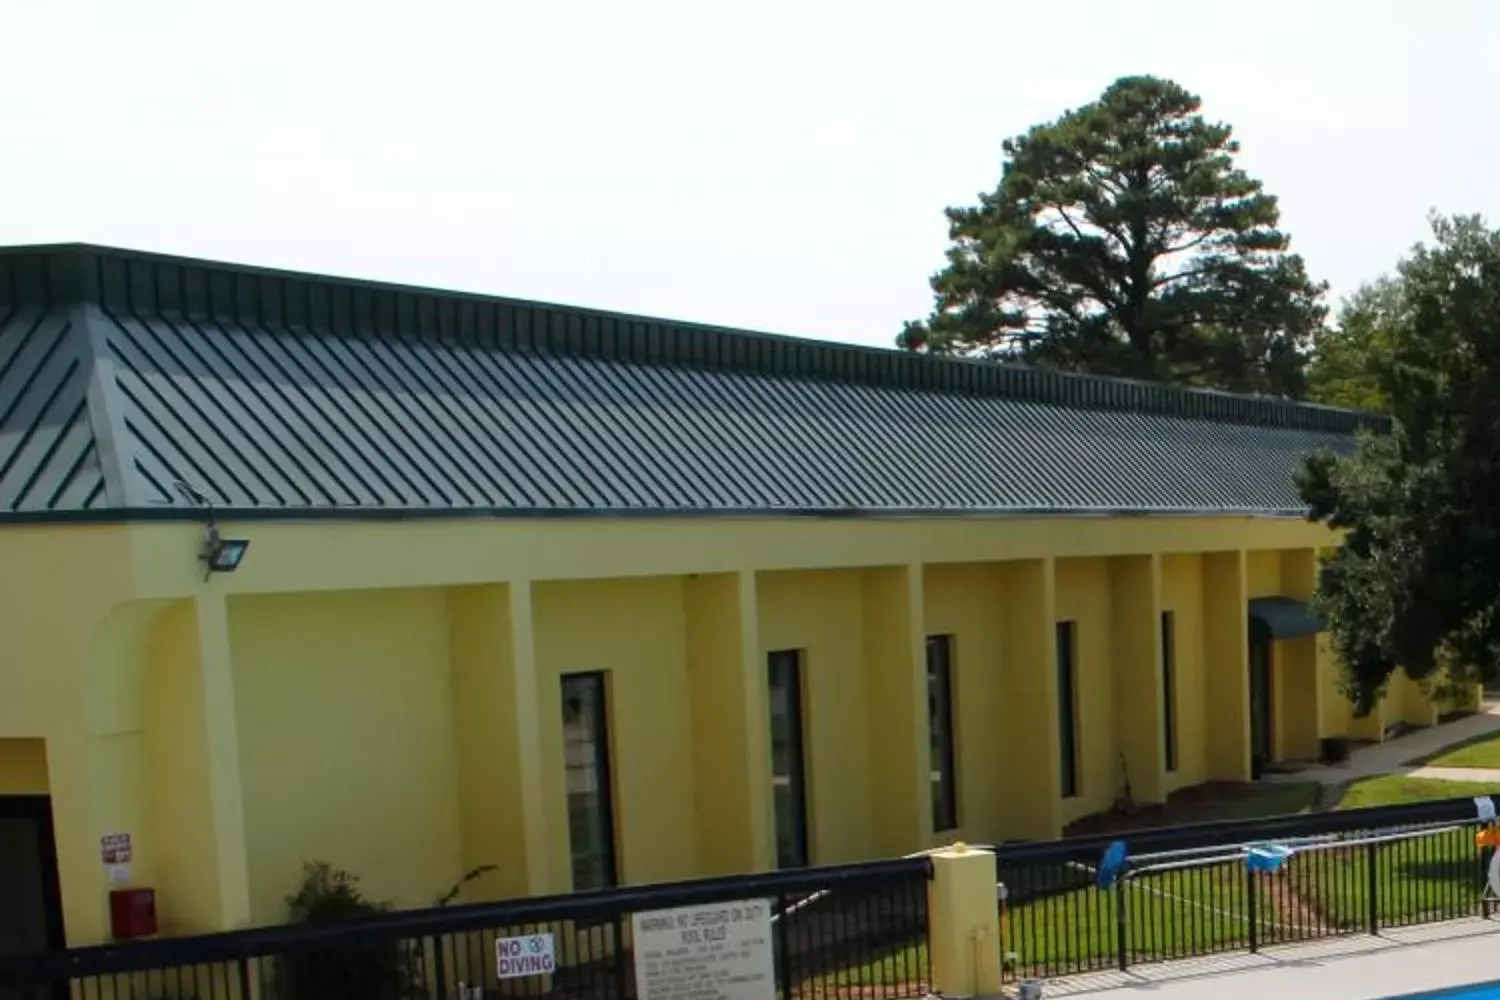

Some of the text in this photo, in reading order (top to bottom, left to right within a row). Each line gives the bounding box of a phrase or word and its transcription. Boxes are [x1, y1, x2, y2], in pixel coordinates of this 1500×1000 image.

[731, 907, 742, 923] ON
[744, 904, 763, 922] DUTY
[498, 940, 521, 957] NO
[499, 954, 553, 974] DIVING
